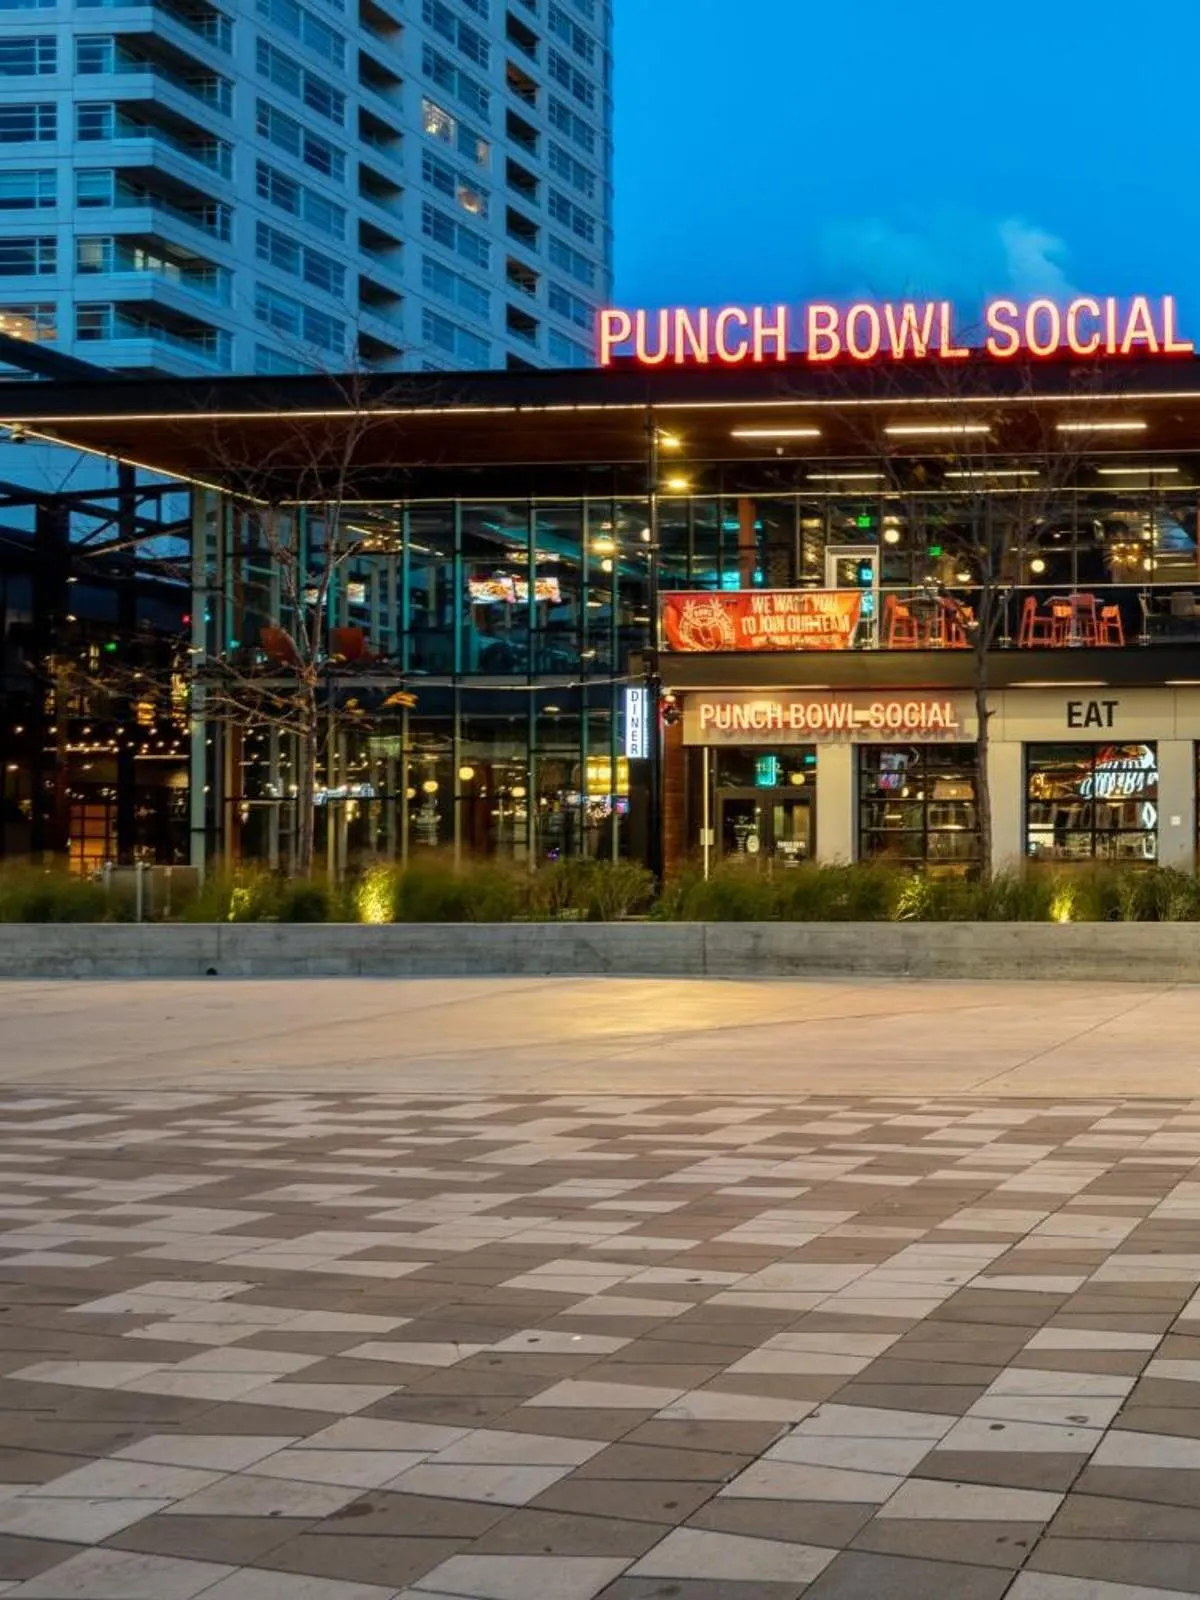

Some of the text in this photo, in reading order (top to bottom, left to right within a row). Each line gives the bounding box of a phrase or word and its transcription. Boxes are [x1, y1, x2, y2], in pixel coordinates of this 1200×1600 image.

[600, 296, 1194, 365] PUNCH BOWL SOCIAL
[751, 594, 772, 613] WE
[741, 616, 757, 635] TO
[813, 614, 851, 632] TEAM
[631, 690, 640, 755] DINER
[700, 702, 960, 729] PUNCH BOWL SOCIAL
[1067, 701, 1119, 728] EAT
